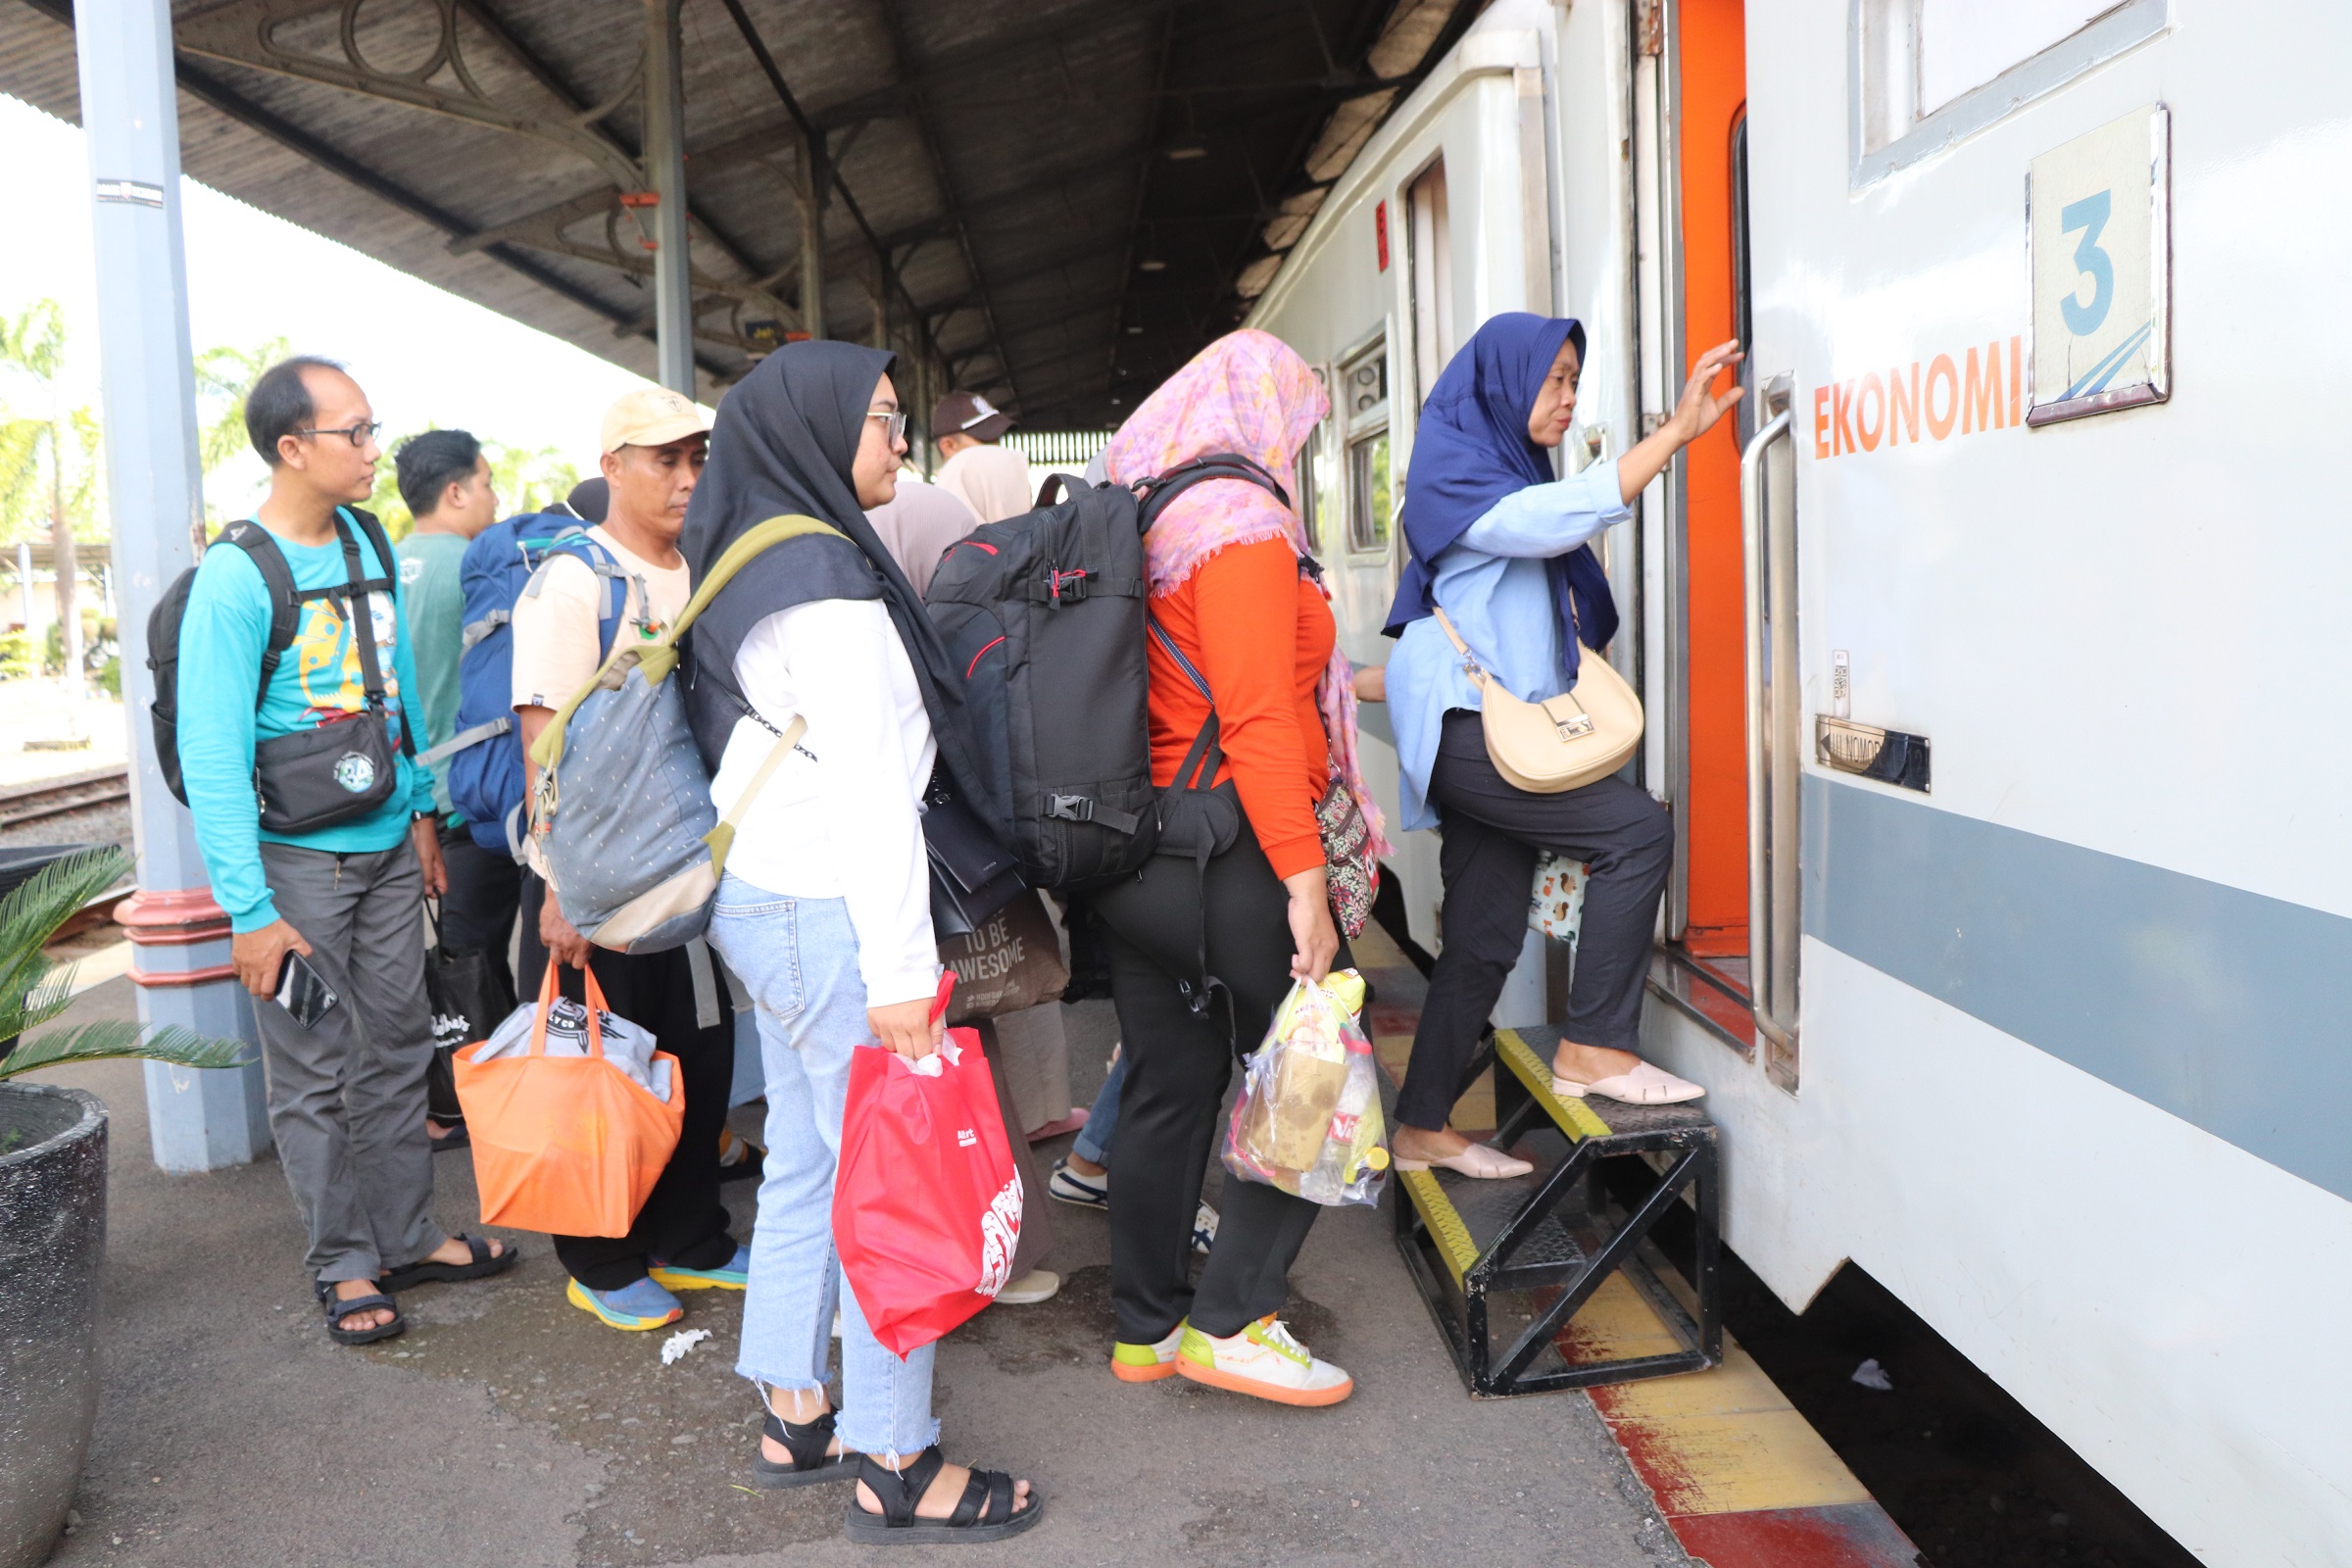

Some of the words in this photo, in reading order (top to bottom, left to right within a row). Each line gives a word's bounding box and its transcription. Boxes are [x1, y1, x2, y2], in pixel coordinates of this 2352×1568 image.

[2060, 187, 2114, 336] 3
[1815, 334, 2022, 460] EKONOMI
[950, 936, 1026, 985] AWESOME
[964, 928, 986, 954] TO
[988, 916, 1010, 948] BE
